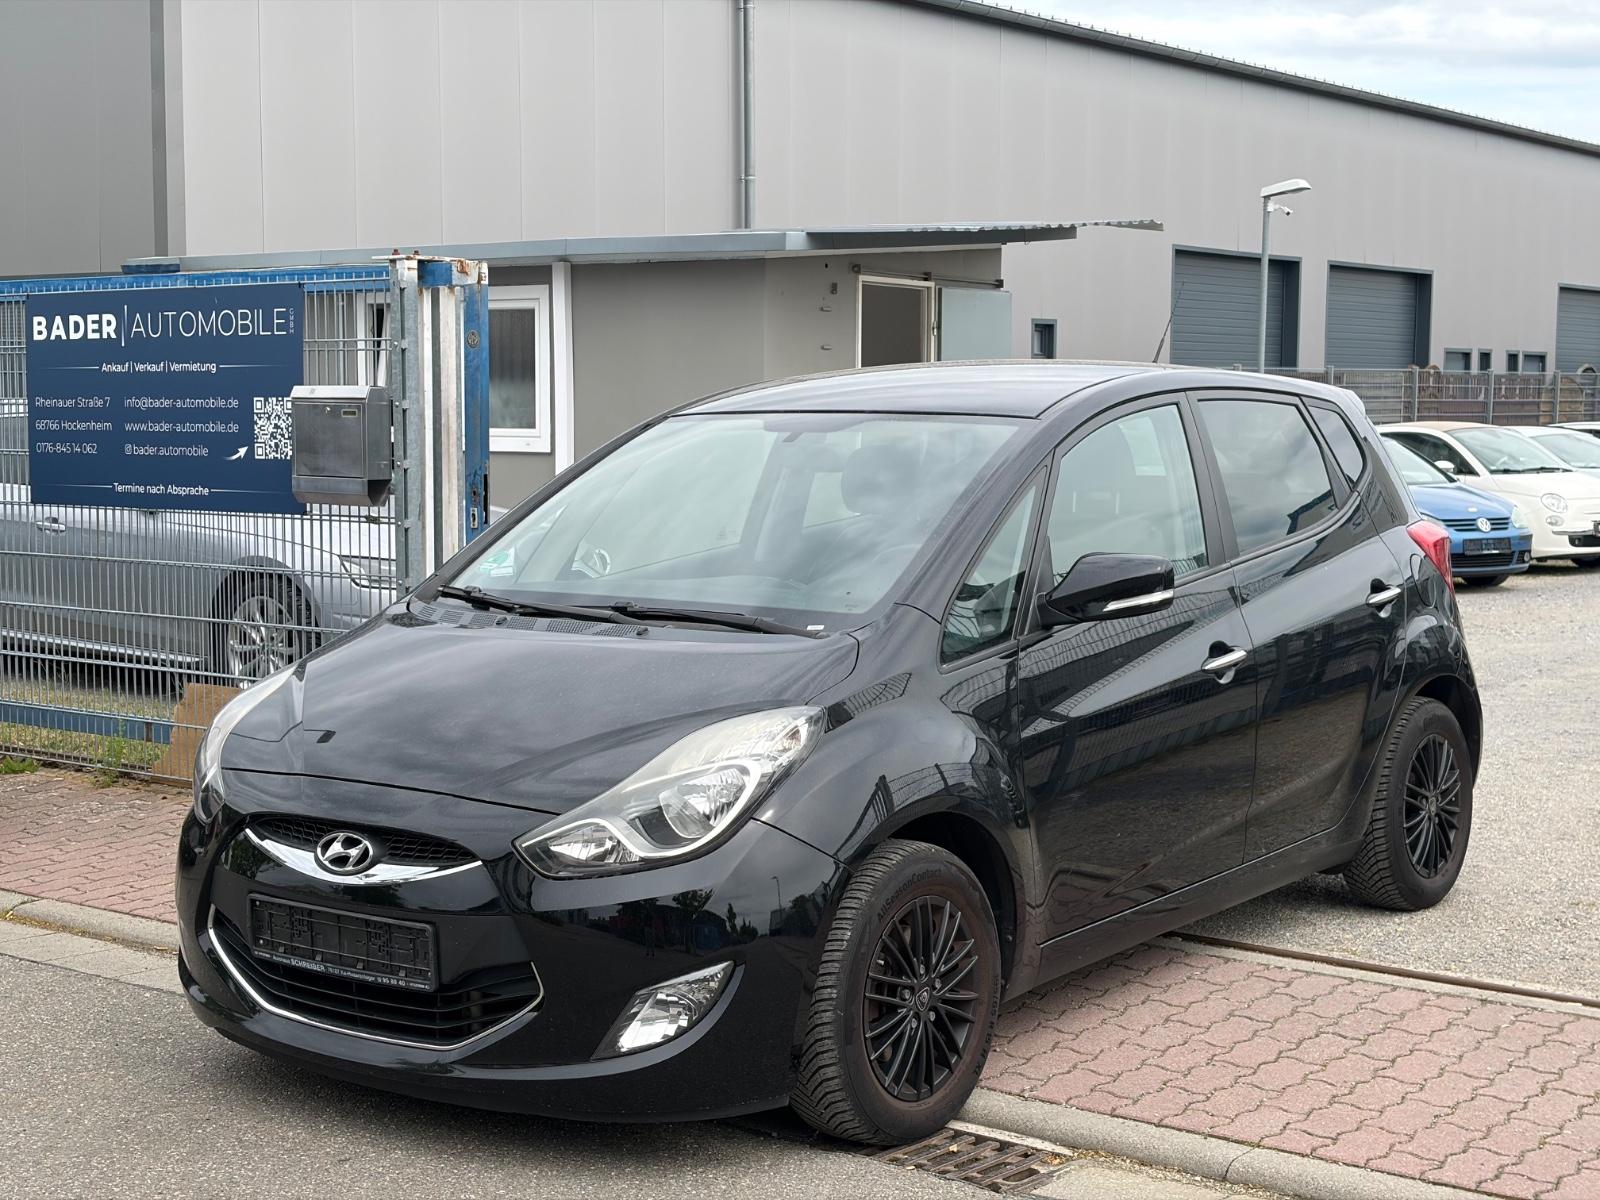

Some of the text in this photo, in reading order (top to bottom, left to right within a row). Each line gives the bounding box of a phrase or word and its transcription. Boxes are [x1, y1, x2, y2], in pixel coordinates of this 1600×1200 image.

[32, 308, 287, 341] BADER AUTOMOBILE
[101, 361, 217, 374] Ankauf Verkauf Vermietung
[35, 397, 111, 408] Rheinauer Straße 7
[124, 397, 239, 411] info@bader-automobile.de
[35, 420, 113, 432] 68766 Hockenheim
[124, 421, 239, 433] www.bader-automobile.de
[82, 443, 98, 454] 062
[113, 483, 209, 497] Termine nach Absprache
